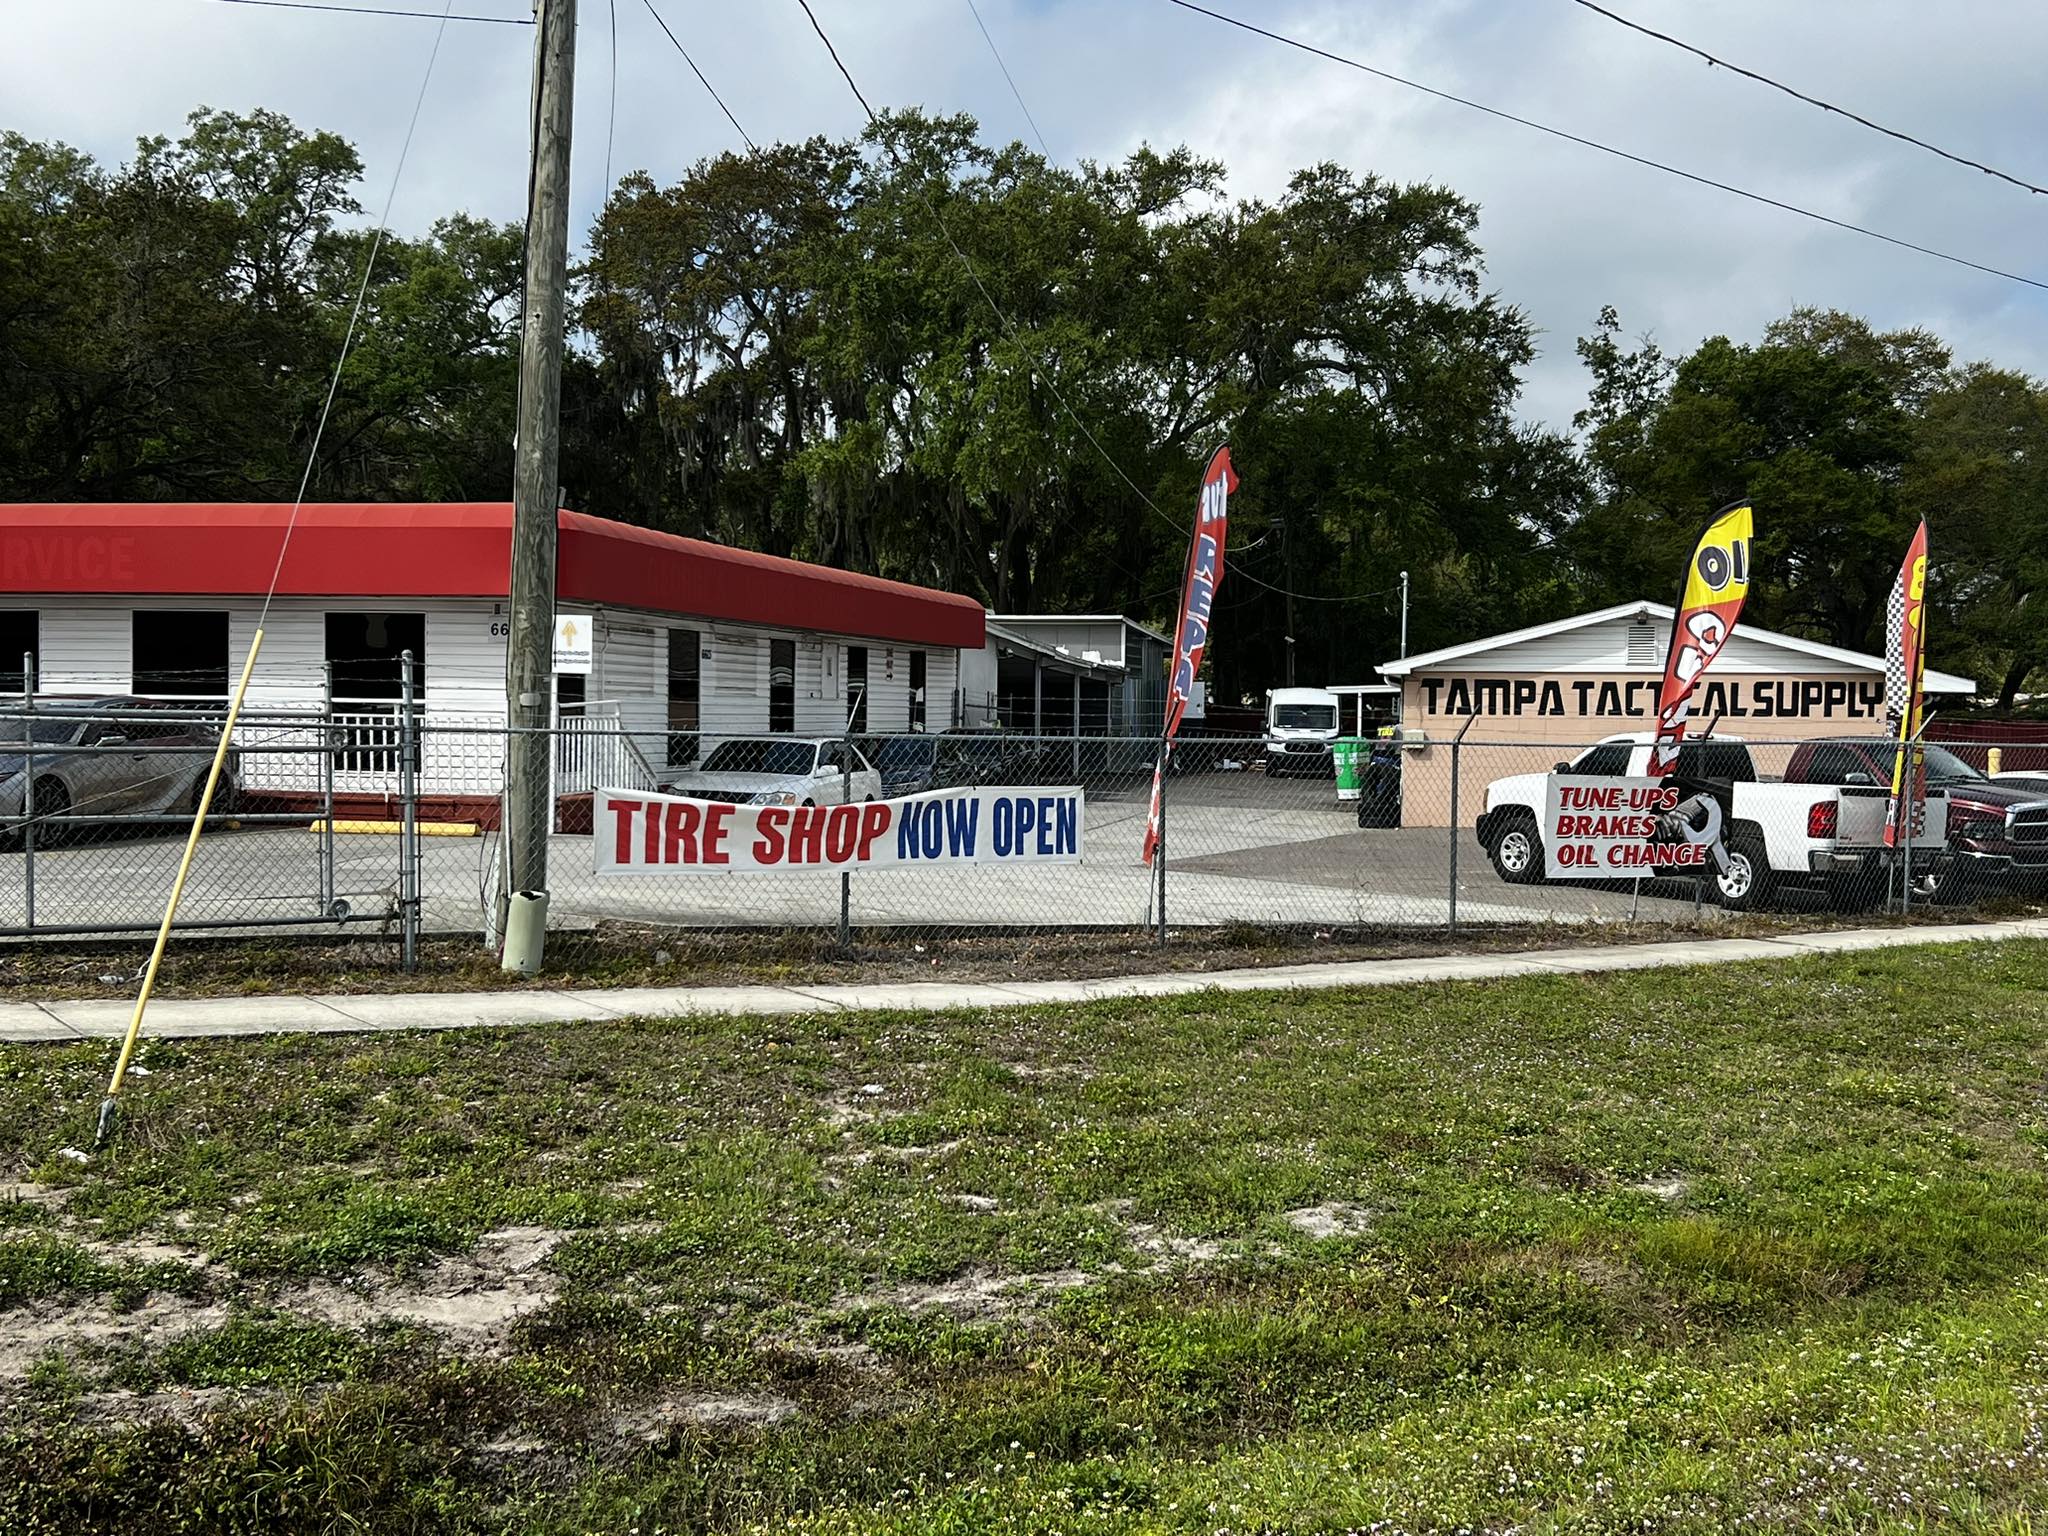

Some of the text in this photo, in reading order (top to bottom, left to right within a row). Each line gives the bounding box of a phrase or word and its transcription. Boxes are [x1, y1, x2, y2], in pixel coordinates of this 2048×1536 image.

[1420, 678, 1883, 718] TAMPA TACTAL SUPPLY
[1559, 786, 1679, 811] TUNE-UPS
[607, 797, 1076, 865] TIRE SHOP NOW OPEN
[1555, 814, 1658, 839] BRAKES
[1556, 843, 1709, 868] OIL CHANGE
